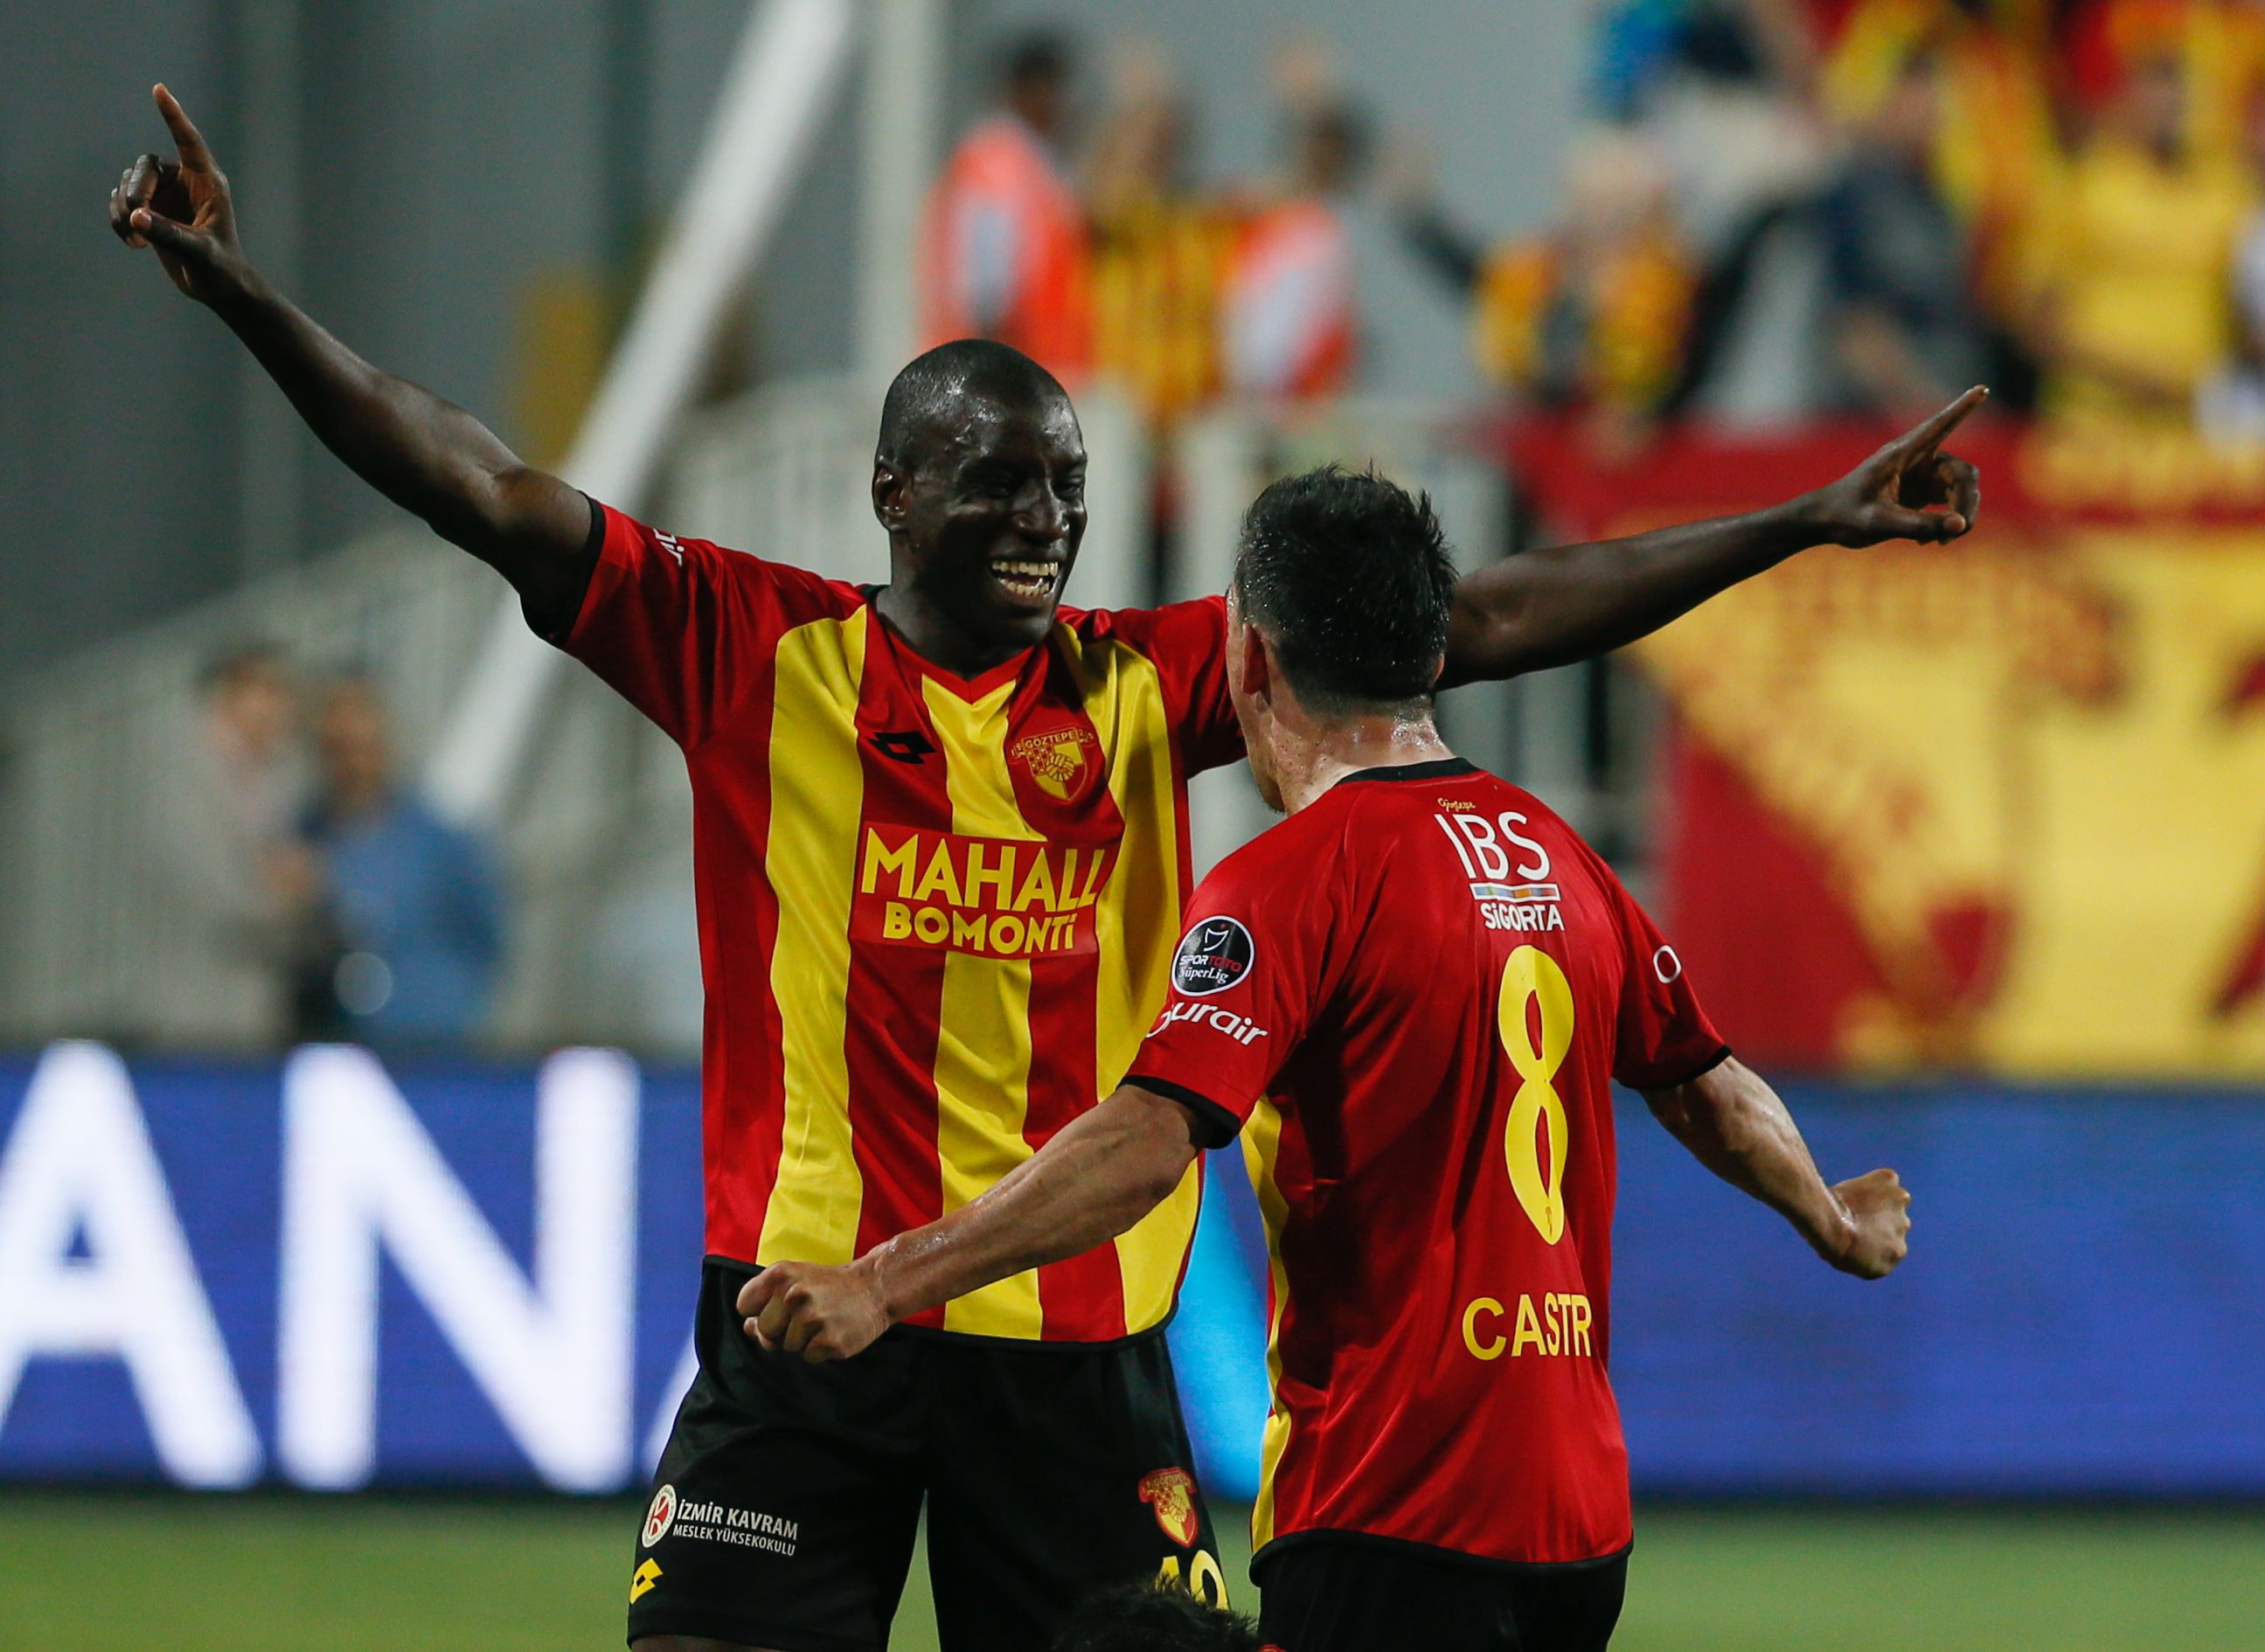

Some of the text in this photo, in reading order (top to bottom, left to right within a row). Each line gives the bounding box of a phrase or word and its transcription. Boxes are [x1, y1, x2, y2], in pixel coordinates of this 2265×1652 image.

[861, 827, 1105, 913] MAHALL
[1434, 811, 1551, 881] IBS
[1497, 944, 1574, 1246] 8
[1463, 1292, 1593, 1361] CASTR
[672, 1523, 796, 1557] MESLEK YÜKSEKOKULU
[726, 1507, 799, 1541] KAVRAM
